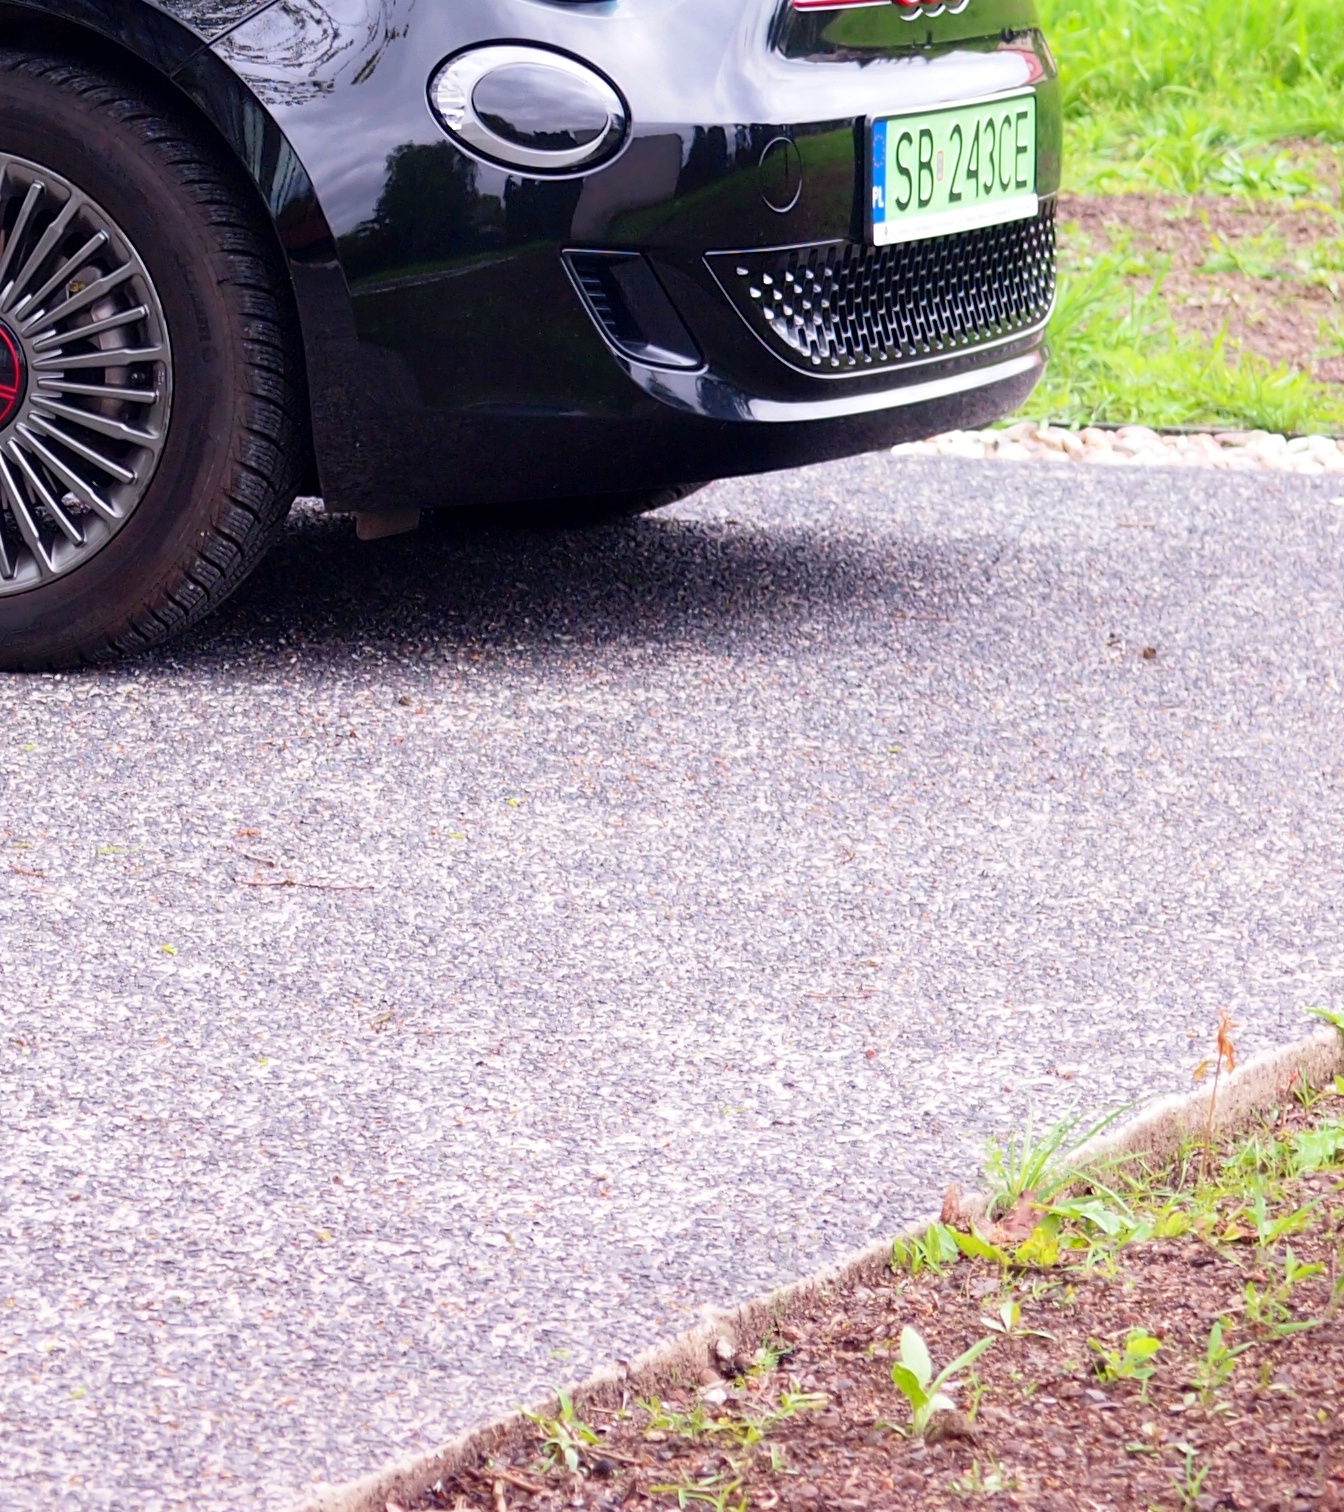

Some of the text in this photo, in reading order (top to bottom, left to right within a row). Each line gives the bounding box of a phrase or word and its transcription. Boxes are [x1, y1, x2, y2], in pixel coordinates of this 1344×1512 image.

[895, 110, 1029, 212] SB 243CE
[872, 185, 885, 210] PL
